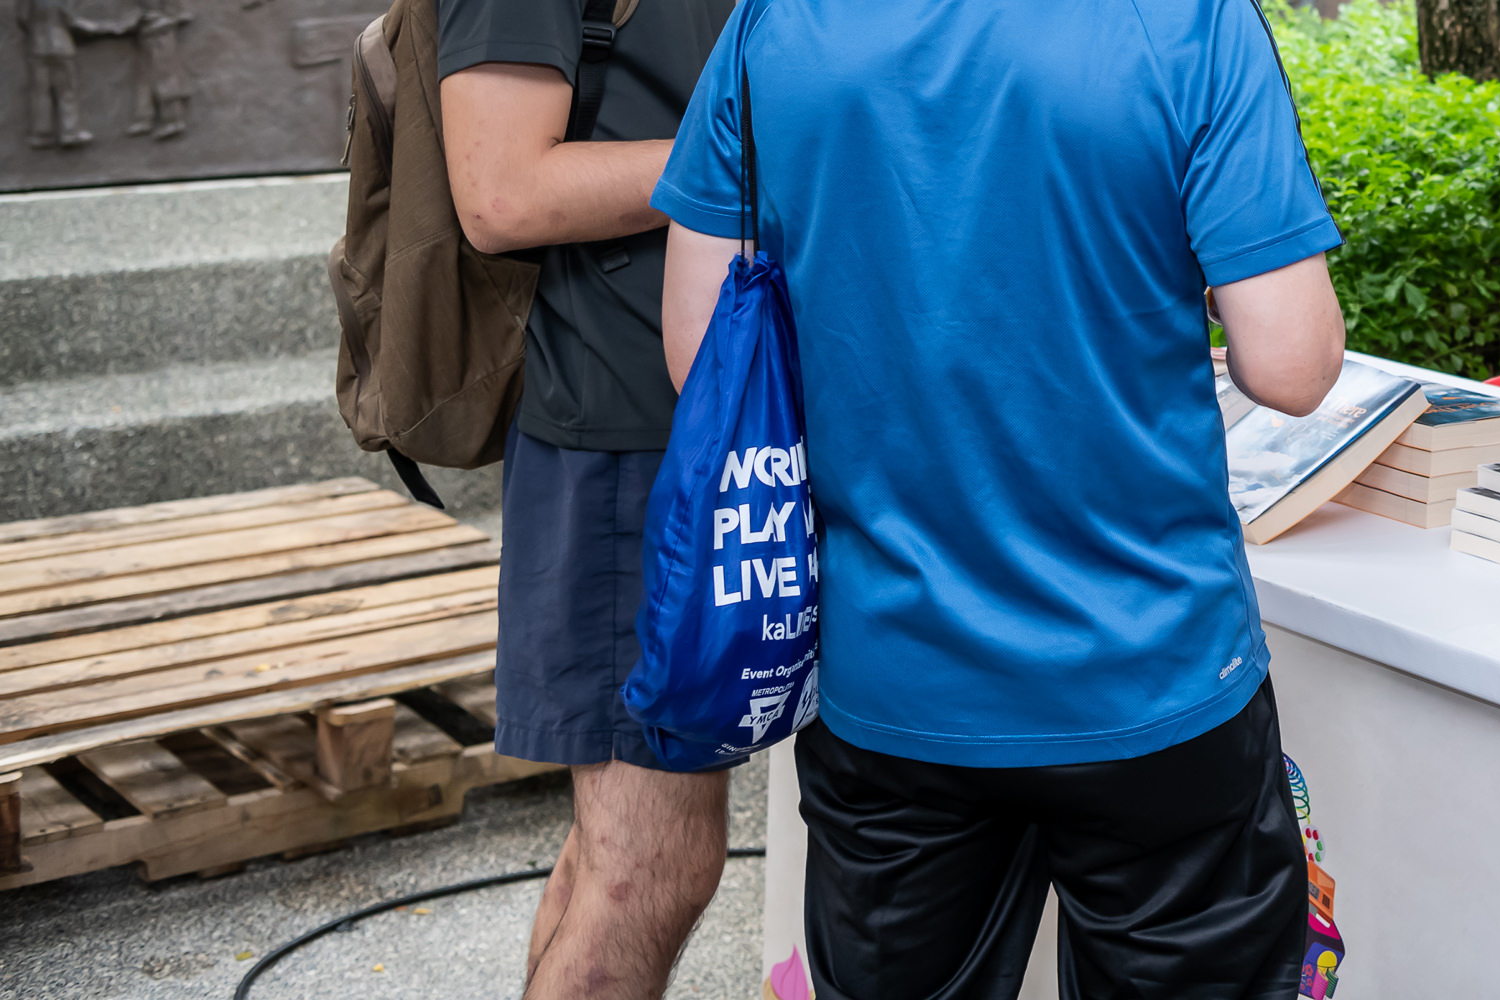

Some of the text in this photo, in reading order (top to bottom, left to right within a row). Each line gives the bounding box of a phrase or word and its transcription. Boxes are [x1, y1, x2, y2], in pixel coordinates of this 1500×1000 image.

[713, 501, 797, 550] PLAY
[713, 556, 800, 607] LIVE
[741, 667, 774, 680] Event
[749, 708, 781, 725] YMCA
